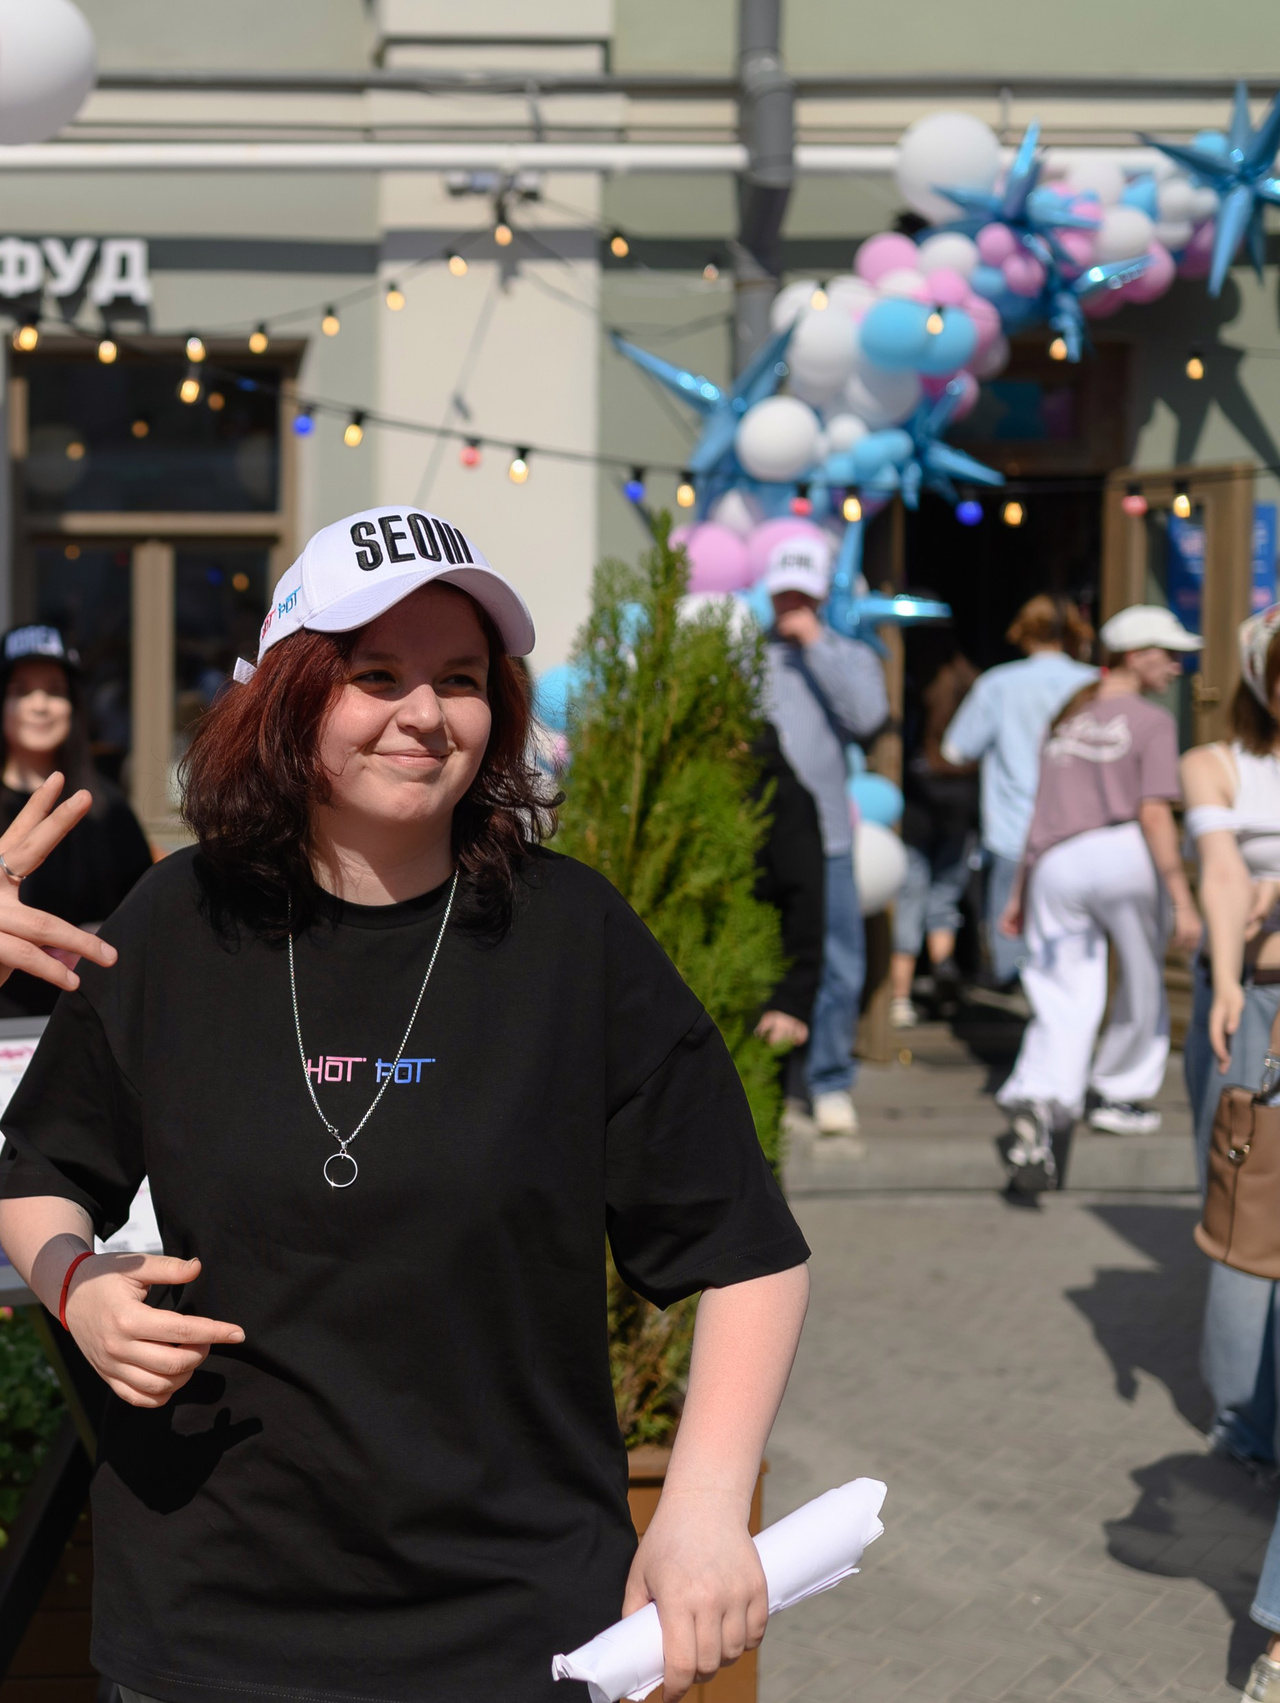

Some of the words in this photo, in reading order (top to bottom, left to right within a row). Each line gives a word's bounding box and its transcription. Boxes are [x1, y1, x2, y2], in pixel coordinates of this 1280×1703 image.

[277, 585, 302, 619] POT
[306, 1055, 368, 1084] HOT
[374, 1057, 437, 1084] POT
